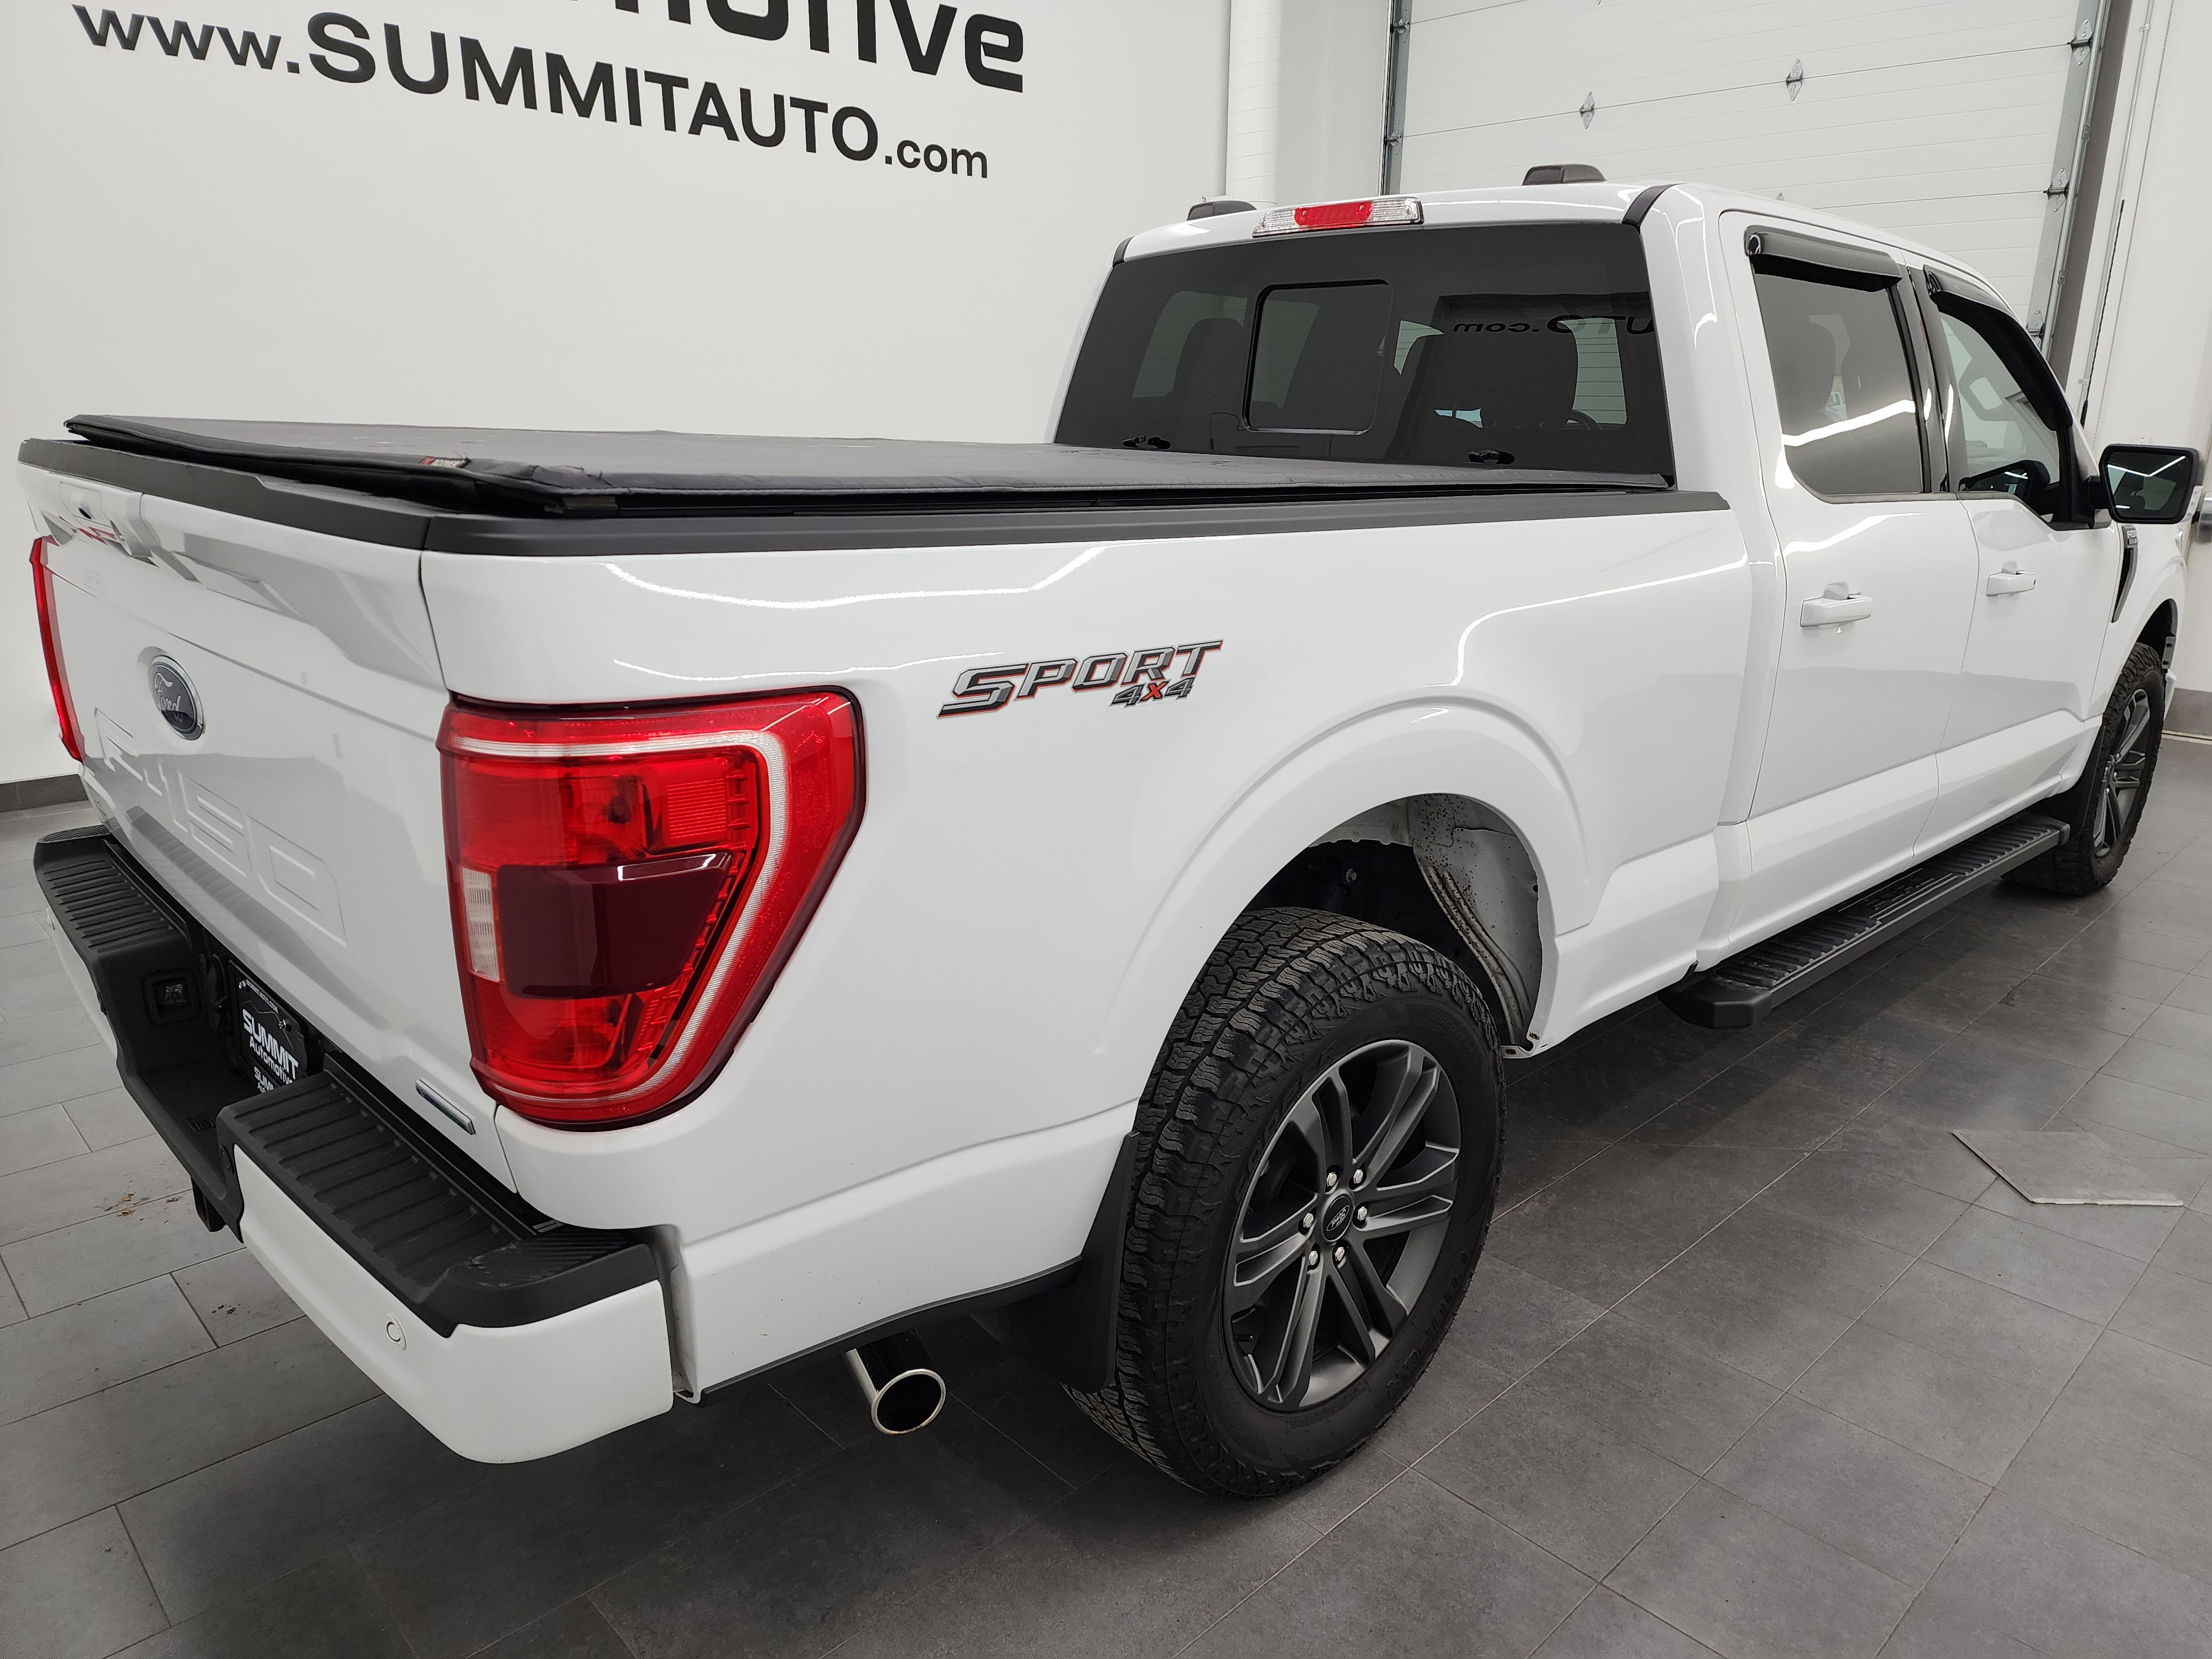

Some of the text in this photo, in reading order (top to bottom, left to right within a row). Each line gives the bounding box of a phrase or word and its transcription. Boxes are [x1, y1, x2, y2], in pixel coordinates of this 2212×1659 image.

[72, 4, 988, 179] www.SUMMITAUTO.com
[152, 671, 182, 722] Ford
[938, 639, 1223, 719] SPORT
[242, 1009, 299, 1081] SUMMIT
